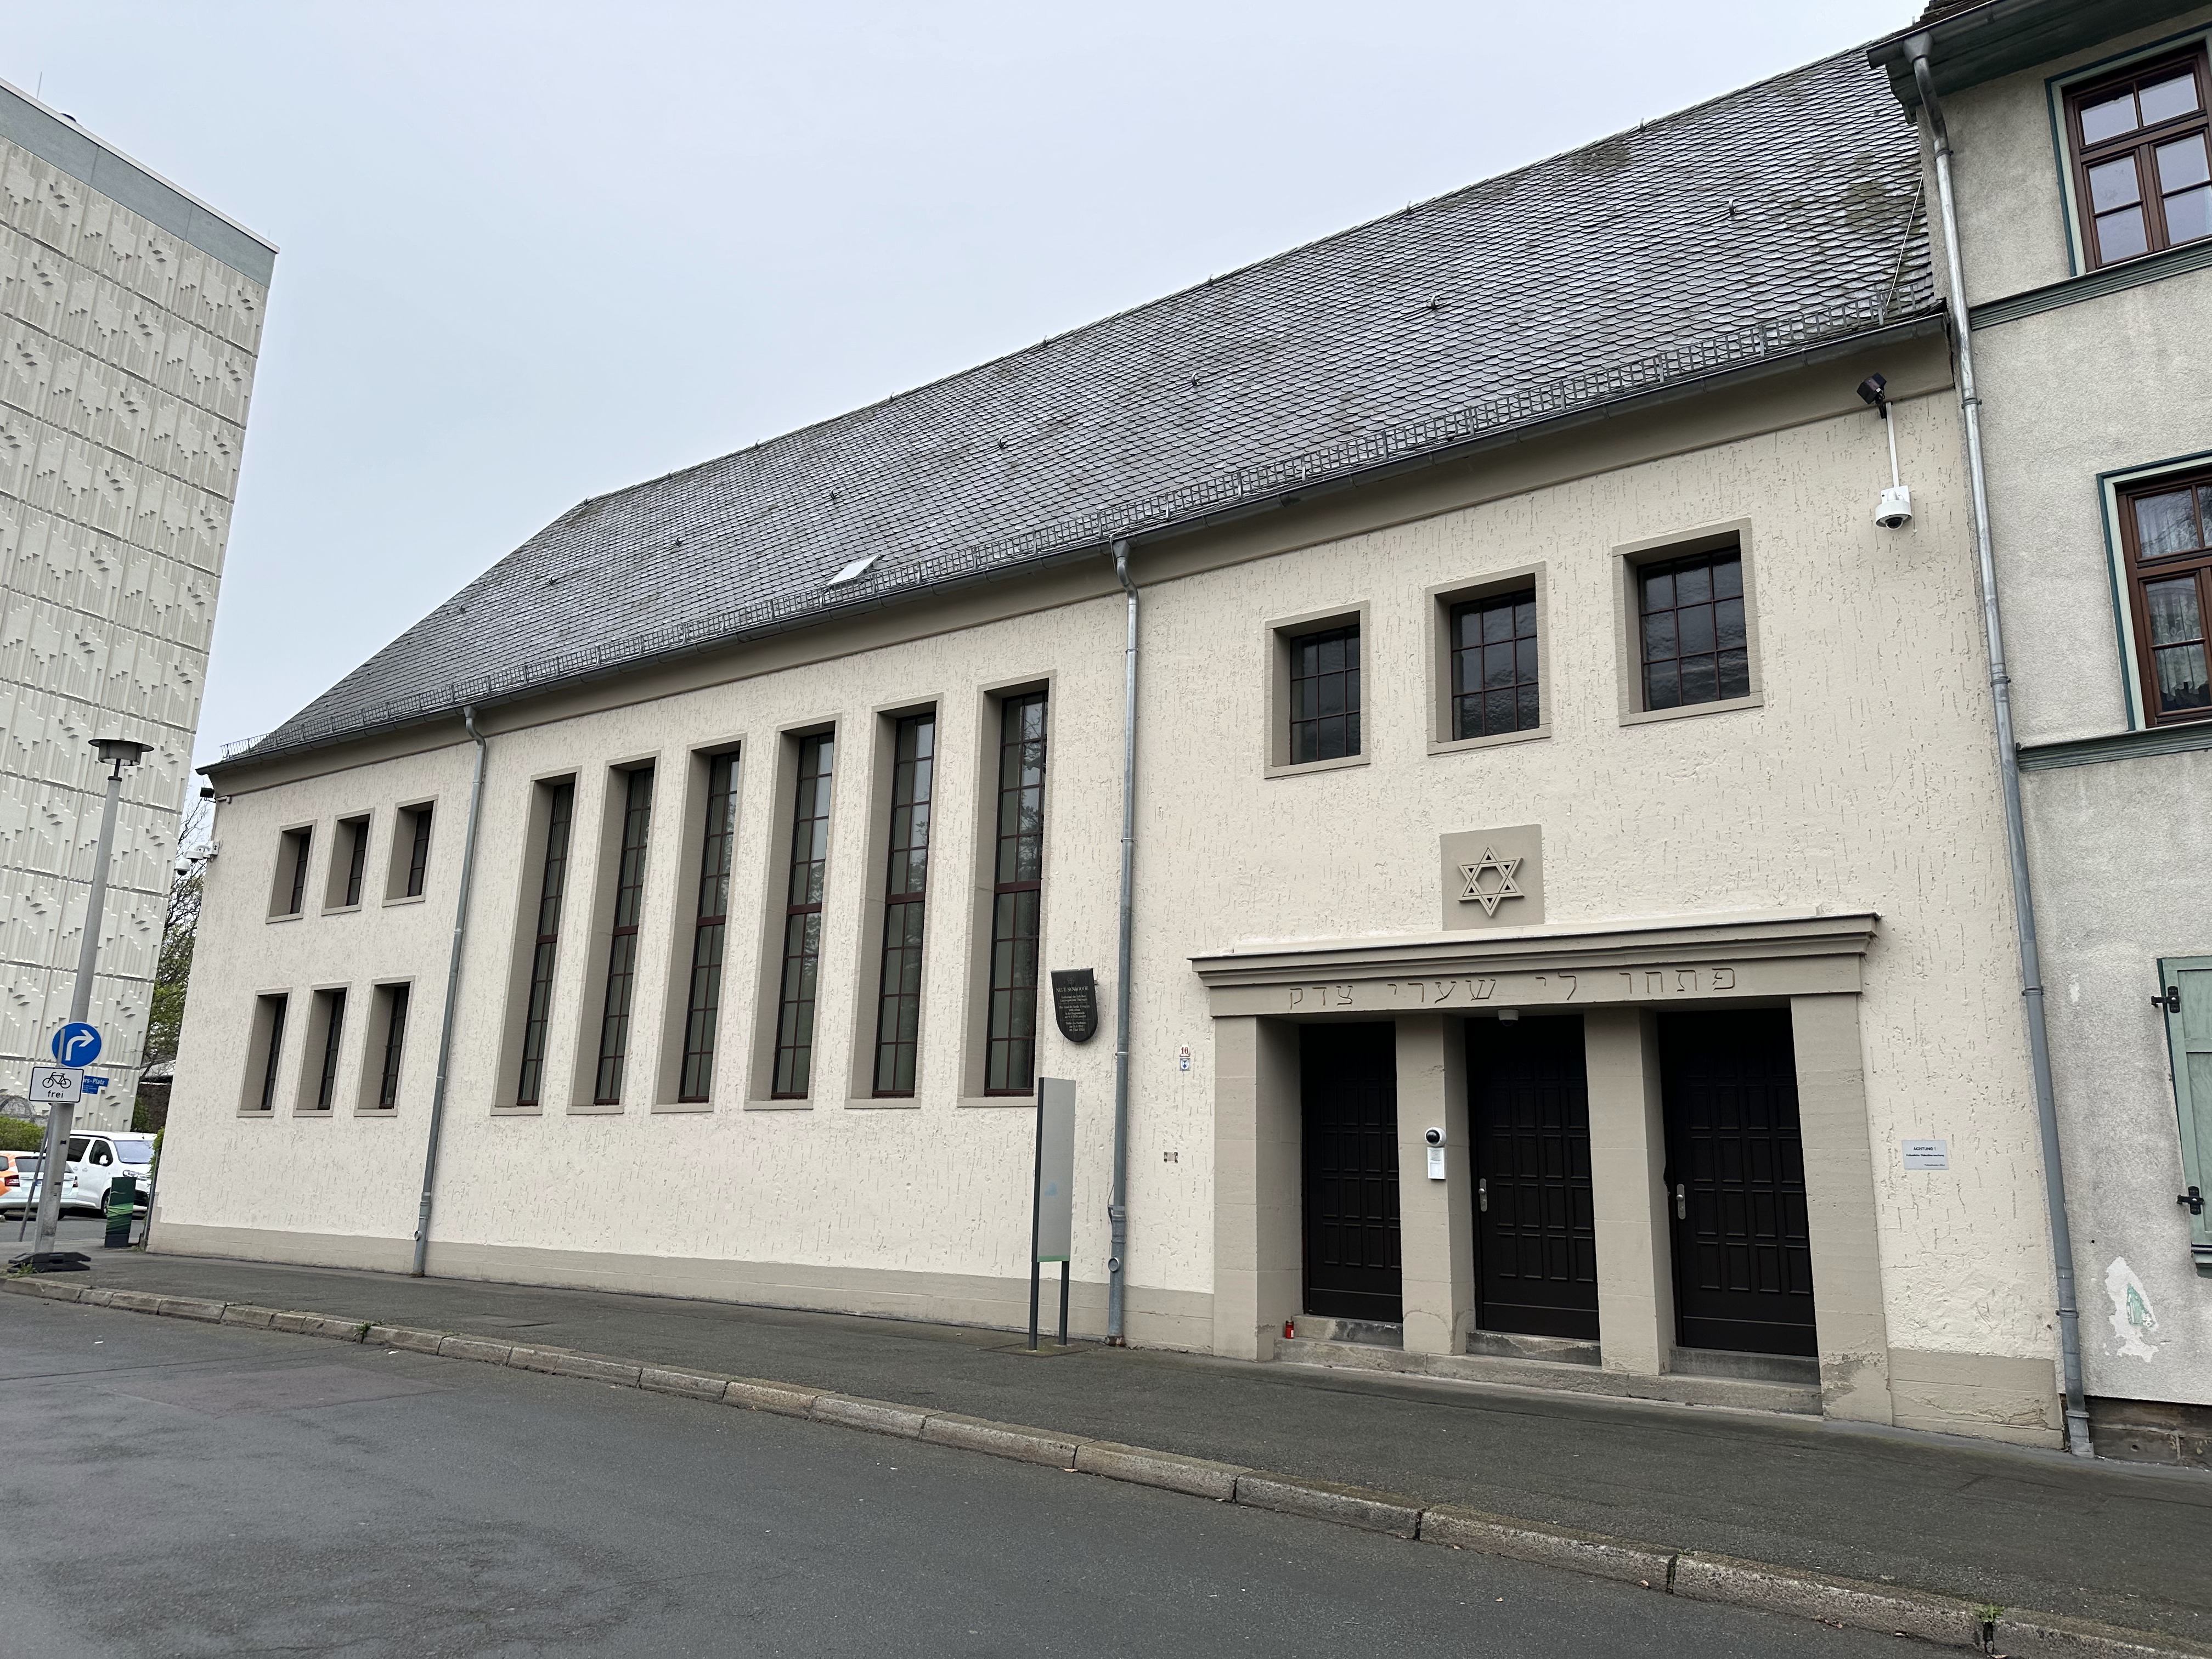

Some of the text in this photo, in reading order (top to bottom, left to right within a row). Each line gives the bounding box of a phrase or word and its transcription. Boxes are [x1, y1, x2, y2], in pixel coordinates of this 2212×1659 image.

[1289, 967, 1735, 1010] פתחו לי שערי צדק
